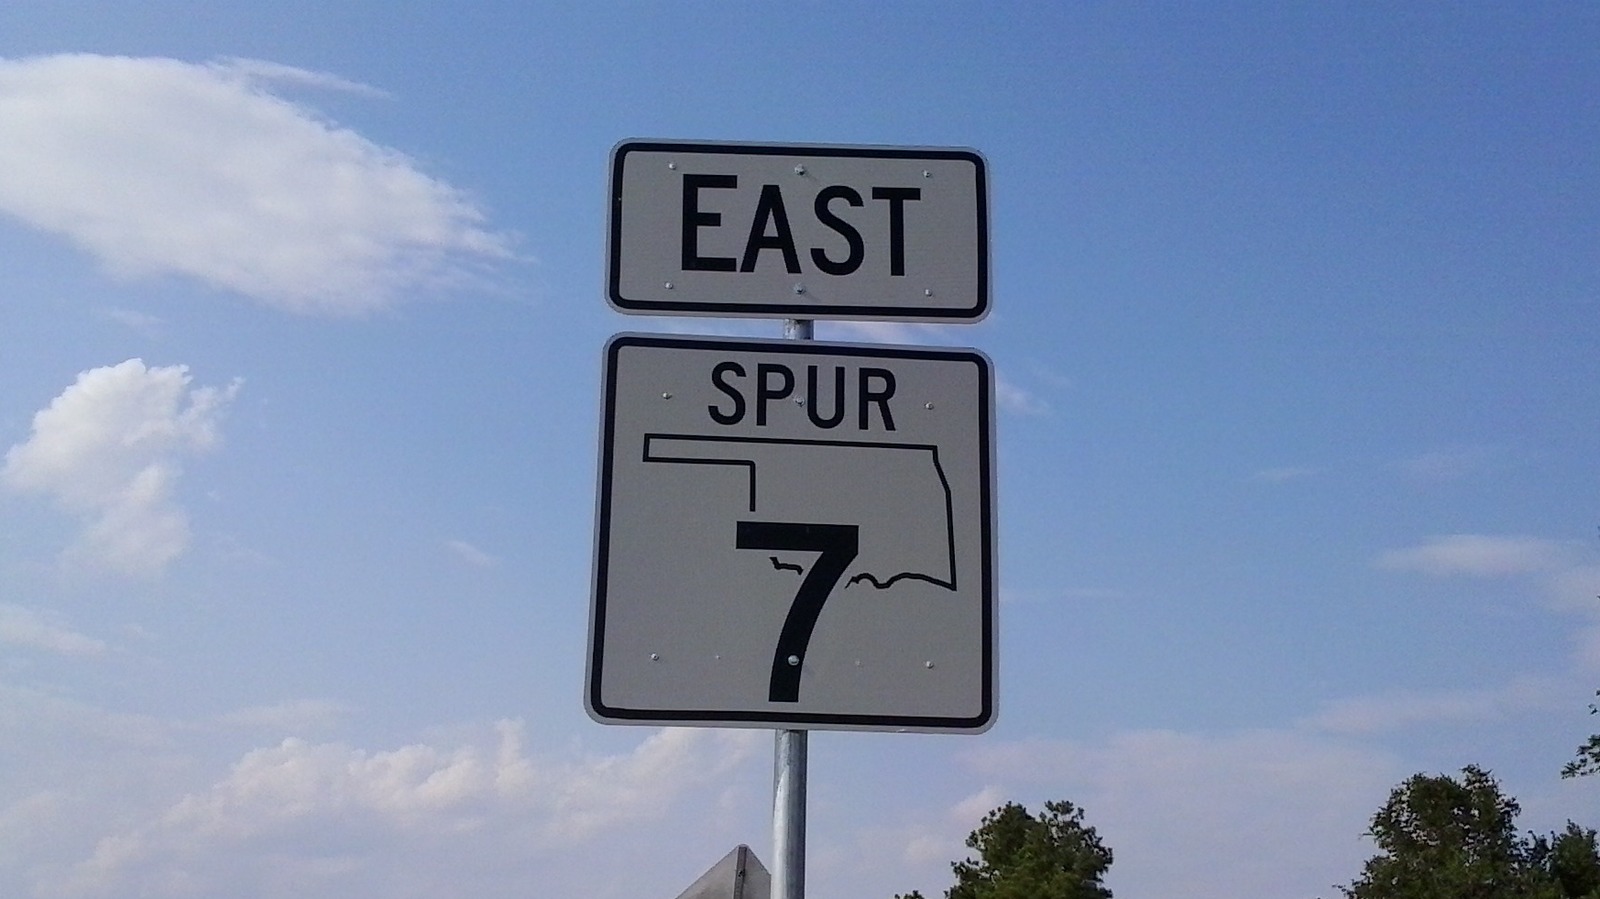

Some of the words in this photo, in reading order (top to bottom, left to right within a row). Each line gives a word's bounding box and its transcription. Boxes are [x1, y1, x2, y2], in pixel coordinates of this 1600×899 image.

[681, 174, 921, 276] EAST
[708, 361, 897, 431] SPUR
[736, 521, 859, 703] 7
